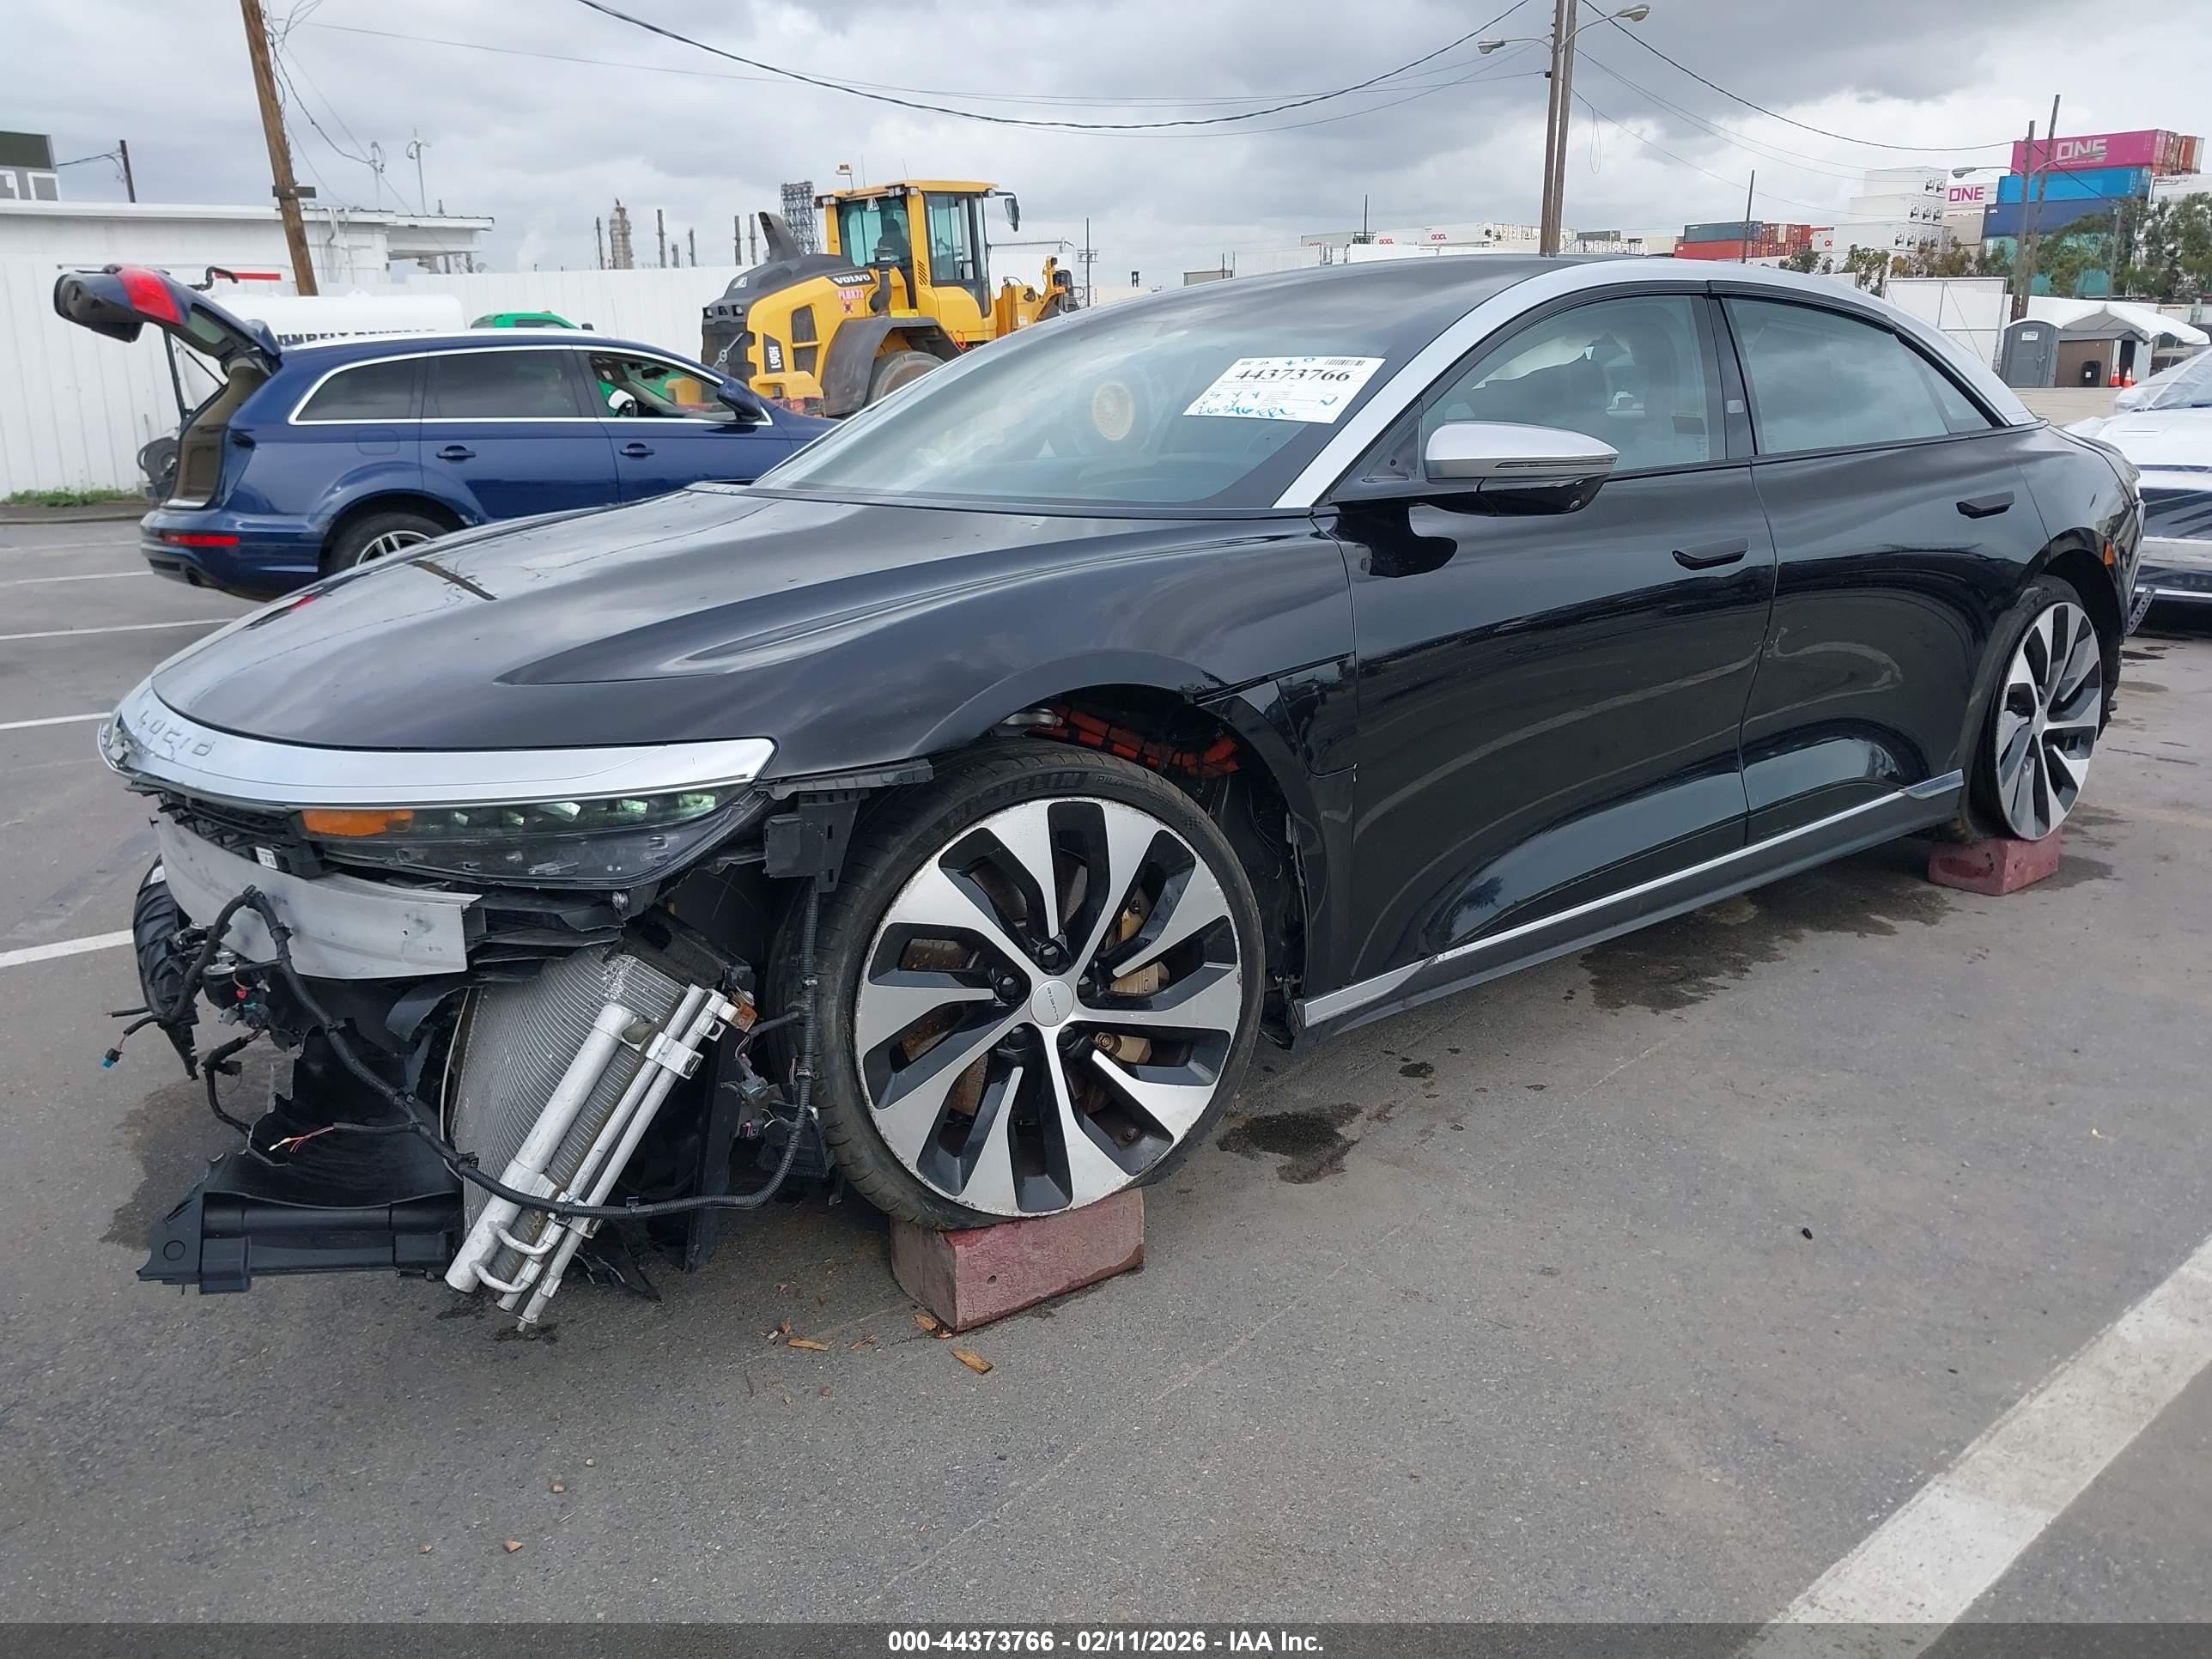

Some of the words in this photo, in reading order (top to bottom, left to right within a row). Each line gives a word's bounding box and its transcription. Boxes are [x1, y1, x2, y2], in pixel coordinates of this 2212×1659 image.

[2056, 138, 2108, 161] ONE
[1948, 186, 1984, 202] ONE
[833, 274, 871, 284] VOLVO
[768, 346, 781, 369] L90H
[1236, 368, 1352, 382] 44373766
[139, 710, 216, 757] LUCID
[1047, 987, 1059, 1021] LUCID
